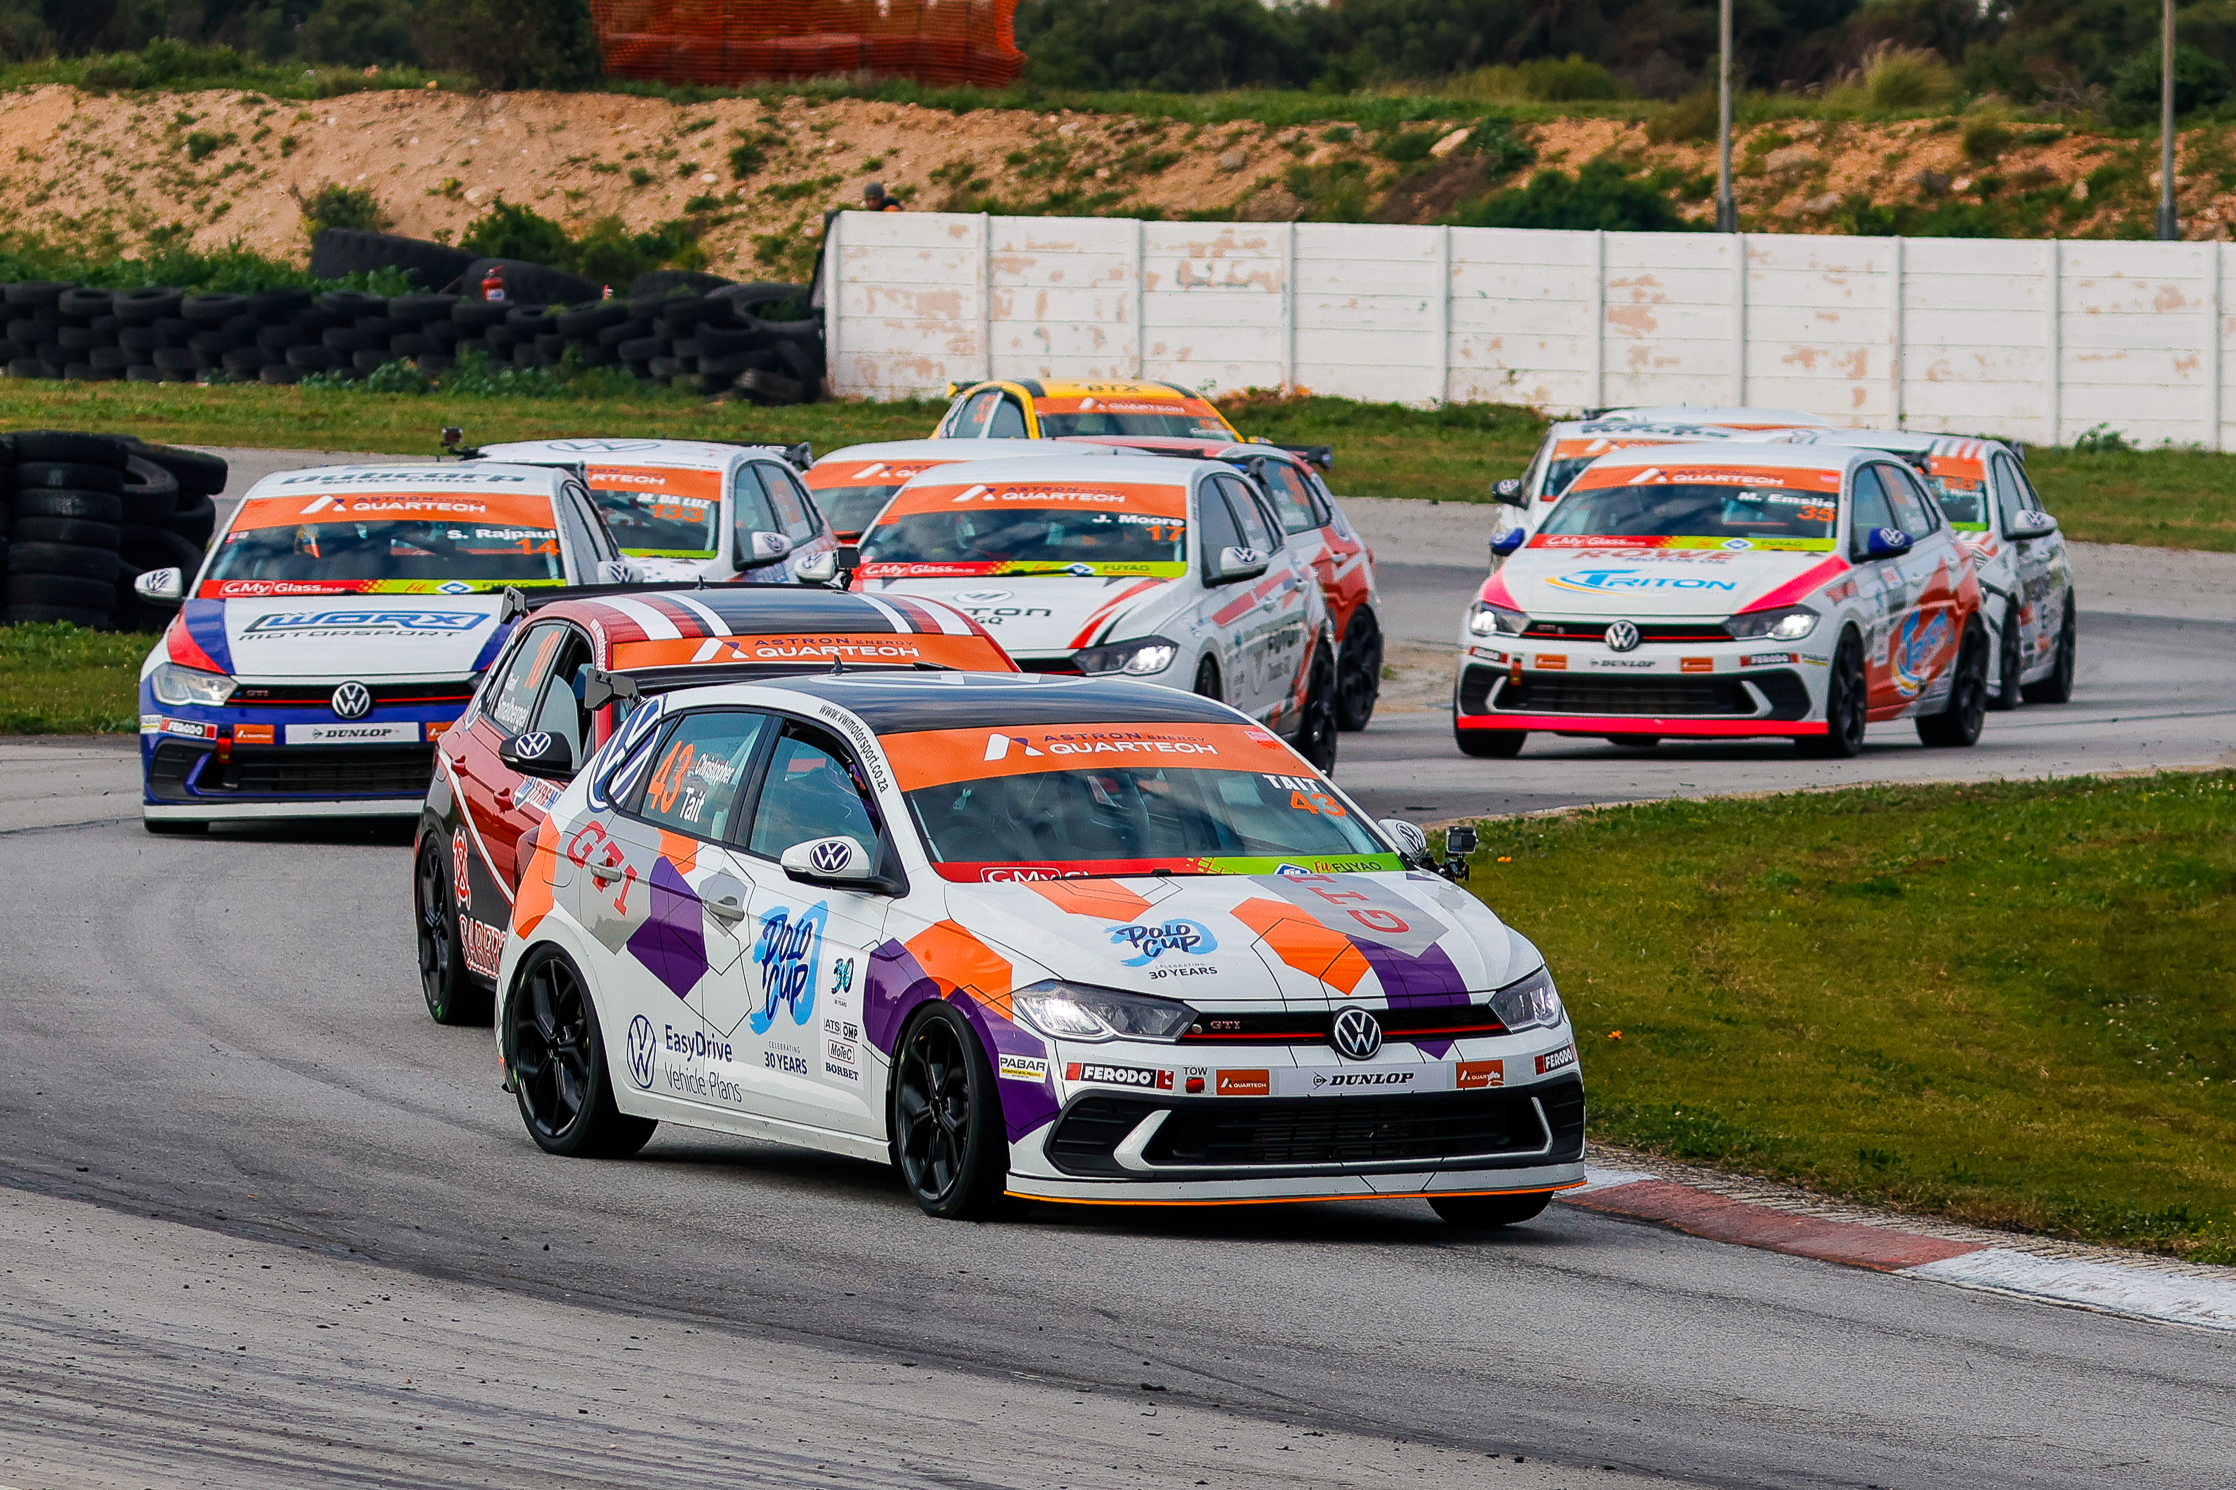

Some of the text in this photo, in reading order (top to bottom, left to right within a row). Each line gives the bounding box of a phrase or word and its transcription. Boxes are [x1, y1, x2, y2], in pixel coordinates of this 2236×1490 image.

[1672, 474, 1785, 486] QUARTECH
[1001, 492, 1126, 503] QUARTECH
[1737, 491, 1837, 508] M. Emslie
[353, 502, 486, 513] QUARTECH
[649, 503, 704, 523] 133
[1796, 505, 1836, 522] 35
[1092, 513, 1184, 526] J. Moore
[447, 528, 556, 541] S. Rajpaul
[1145, 526, 1186, 541] 17
[514, 538, 560, 556] 14
[1572, 549, 1743, 560] ROWE
[1577, 569, 1737, 591] TRITON
[264, 612, 474, 627] WORX
[237, 630, 463, 640] MOTORSPORT
[755, 638, 914, 647] ASTRON ENERGY
[755, 646, 920, 657] QUARTECH
[524, 630, 562, 690] 10
[167, 720, 204, 735] FERODO
[325, 727, 392, 739] DUNLOP
[1044, 732, 1206, 743] ASTRON ENERGY
[819, 704, 889, 794] www.vwmotorsport.co.za
[1049, 741, 1219, 756] QUARTECH
[695, 752, 735, 785] Christopher
[648, 740, 695, 814] 43
[1262, 774, 1321, 792] TAIT
[679, 787, 705, 824] Tait
[1290, 790, 1347, 817] 43
[567, 821, 638, 917] GTI
[1332, 860, 1383, 872] FUYAO
[1142, 932, 1201, 957] CUP
[1148, 965, 1218, 980] 30 YEARS
[766, 963, 809, 1020] CUP
[824, 1019, 840, 1033] ATS
[843, 1025, 858, 1040] OMP
[1210, 1020, 1241, 1030] GTI
[664, 1024, 733, 1063] EasyDrive
[768, 1041, 801, 1054] CELEBRATING
[830, 1042, 852, 1061] MoTeC
[1545, 1047, 1574, 1070] FERODO
[764, 1051, 808, 1075] 30 YEARS
[1000, 1056, 1046, 1071] PABAR
[825, 1062, 859, 1082] BORBET
[1083, 1064, 1153, 1085] FERODO
[1183, 1066, 1208, 1076] TOW
[664, 1062, 743, 1104] Vehicle Plans
[1329, 1072, 1415, 1086] DUNLOP
